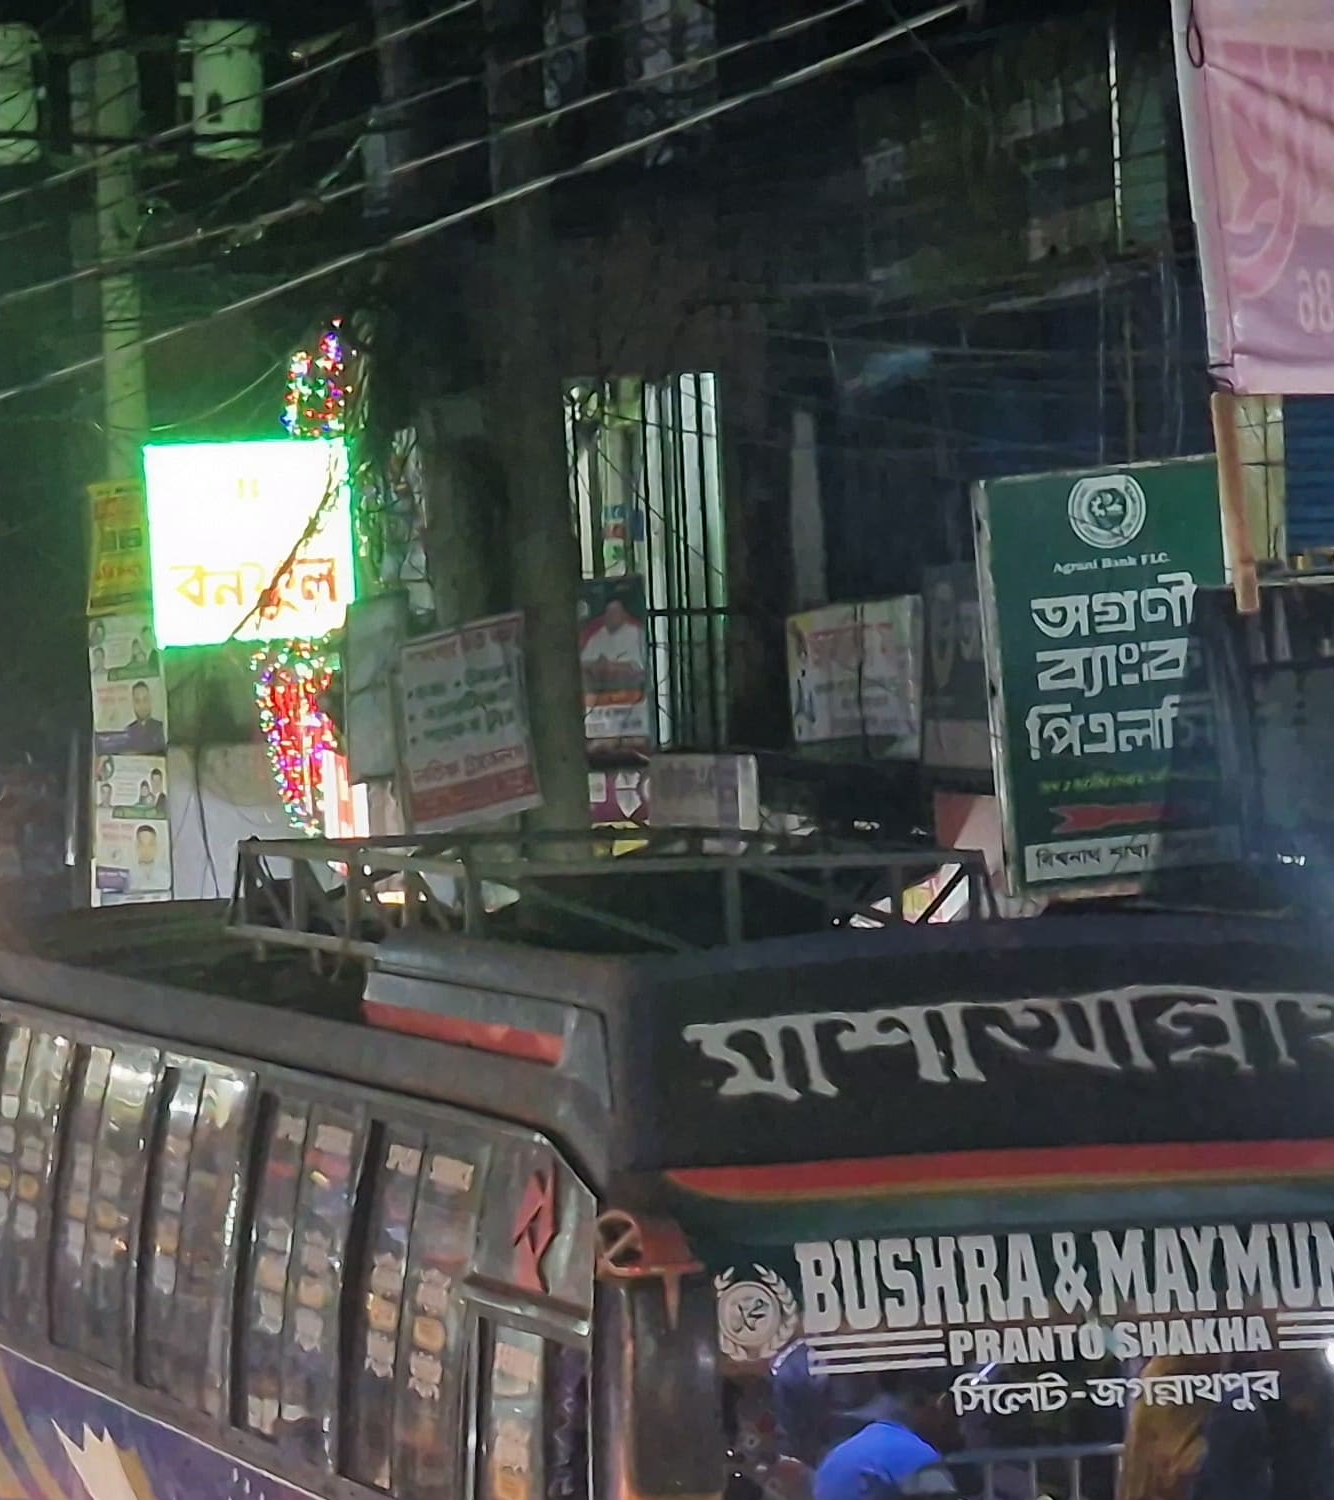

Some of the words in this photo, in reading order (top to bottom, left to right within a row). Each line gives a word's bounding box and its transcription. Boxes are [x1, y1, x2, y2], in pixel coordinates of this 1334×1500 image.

[1030, 571, 1198, 638] অগ্রণী
[794, 1236, 1049, 1334] BUSHRA
[1051, 1231, 1094, 1313] &
[948, 1323, 1106, 1366] PRANTO
[1114, 1316, 1272, 1359] SHAKHA
